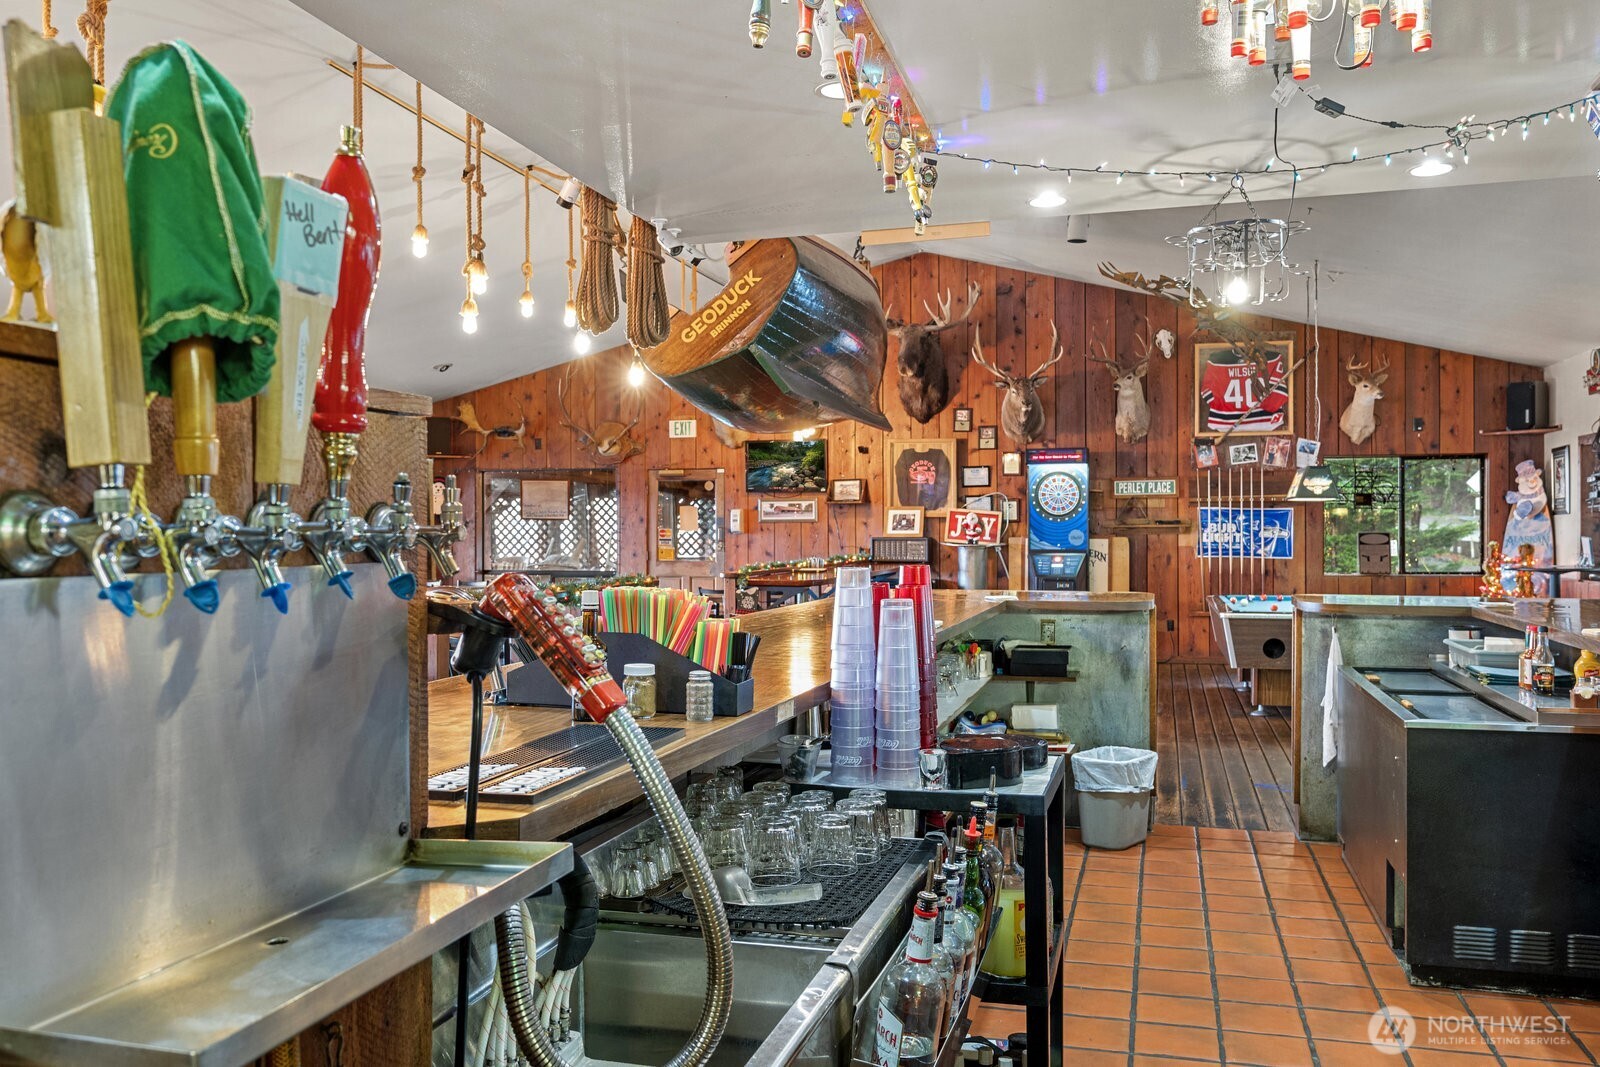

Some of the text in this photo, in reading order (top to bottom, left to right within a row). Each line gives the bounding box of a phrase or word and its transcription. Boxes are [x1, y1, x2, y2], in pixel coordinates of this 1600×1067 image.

[285, 200, 315, 223] Hell
[302, 220, 347, 248] Bent
[680, 268, 763, 344] GEODUCK
[709, 299, 752, 339] BRINNON
[1223, 377, 1266, 409] 40
[673, 421, 692, 436] EXIT
[1118, 481, 1172, 494] PERLEY PLACE
[950, 514, 997, 541] JY
[1208, 522, 1237, 533] BUD
